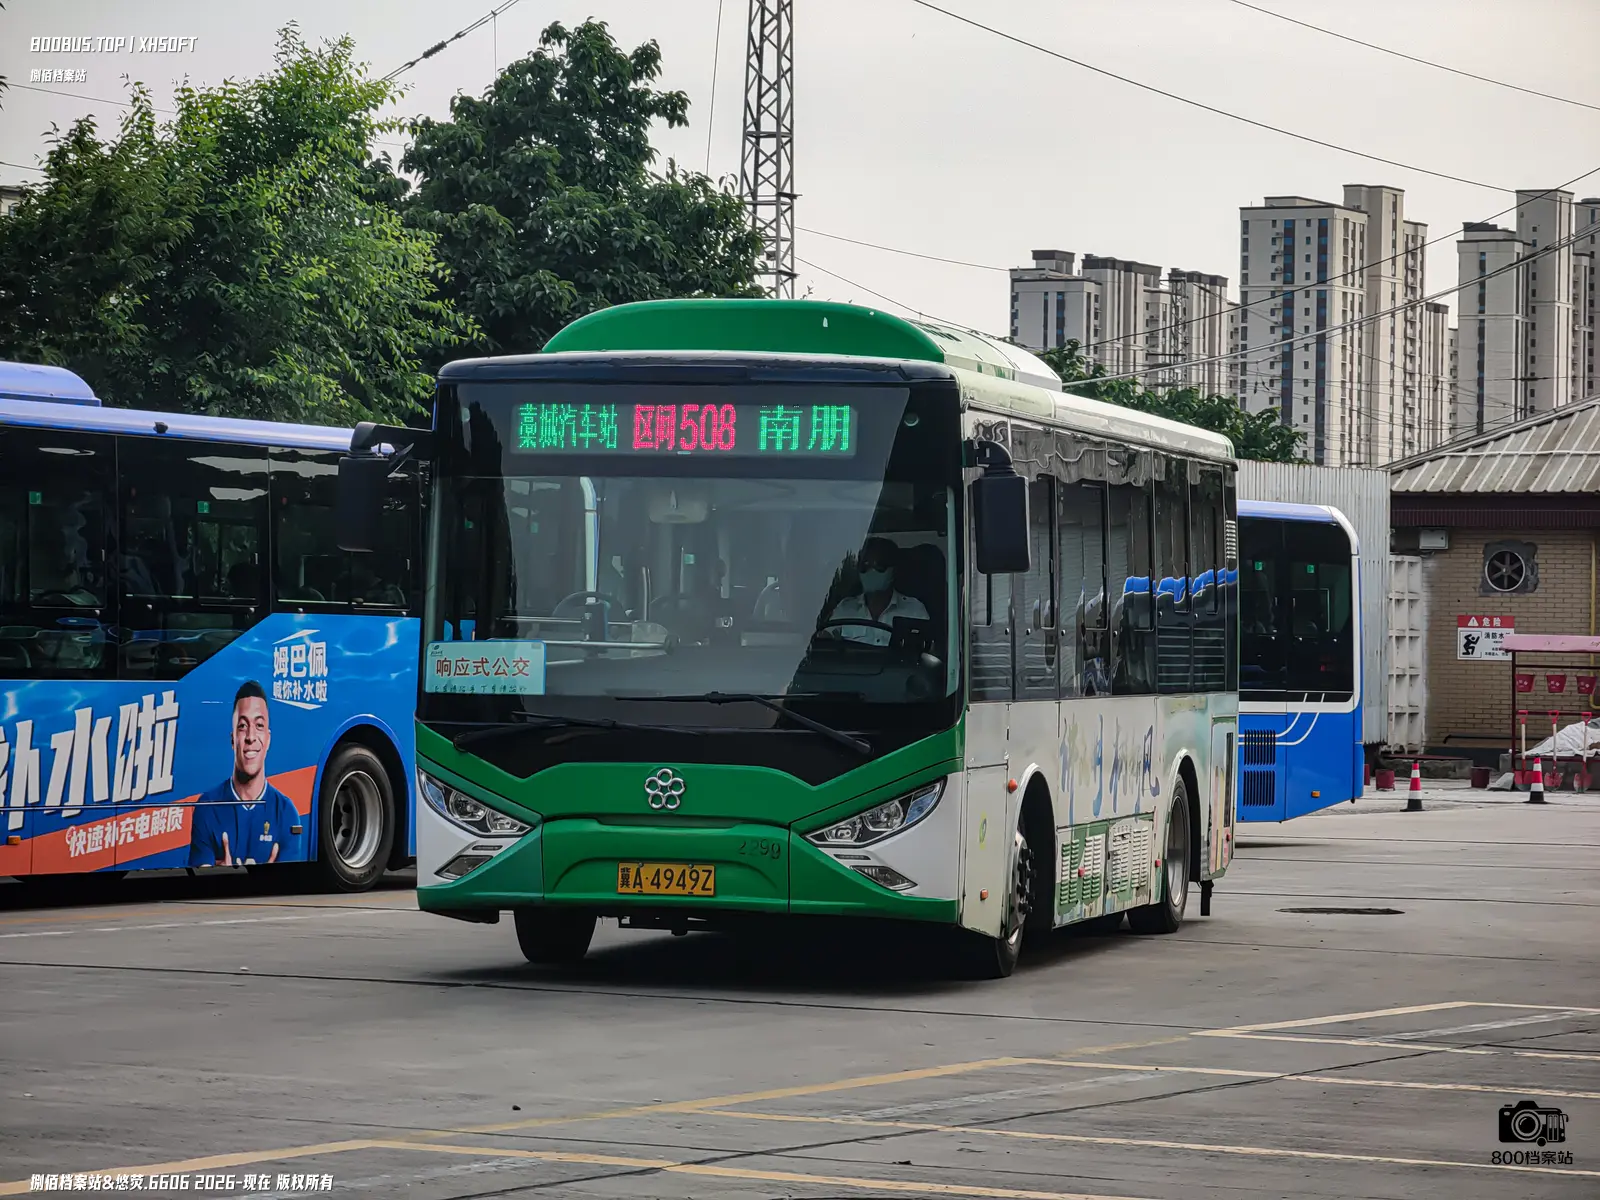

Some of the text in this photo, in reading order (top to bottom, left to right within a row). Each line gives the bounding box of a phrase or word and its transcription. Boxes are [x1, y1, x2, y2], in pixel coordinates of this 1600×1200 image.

[517, 403, 852, 451] 藁城汽车站 区间508 南朋
[1484, 632, 1511, 640] 消防水
[273, 641, 329, 678] 姆巴佩
[436, 656, 531, 678] 响应式公交
[272, 679, 328, 702] 喊你补水啦
[69, 806, 184, 858] 快速补充电解质
